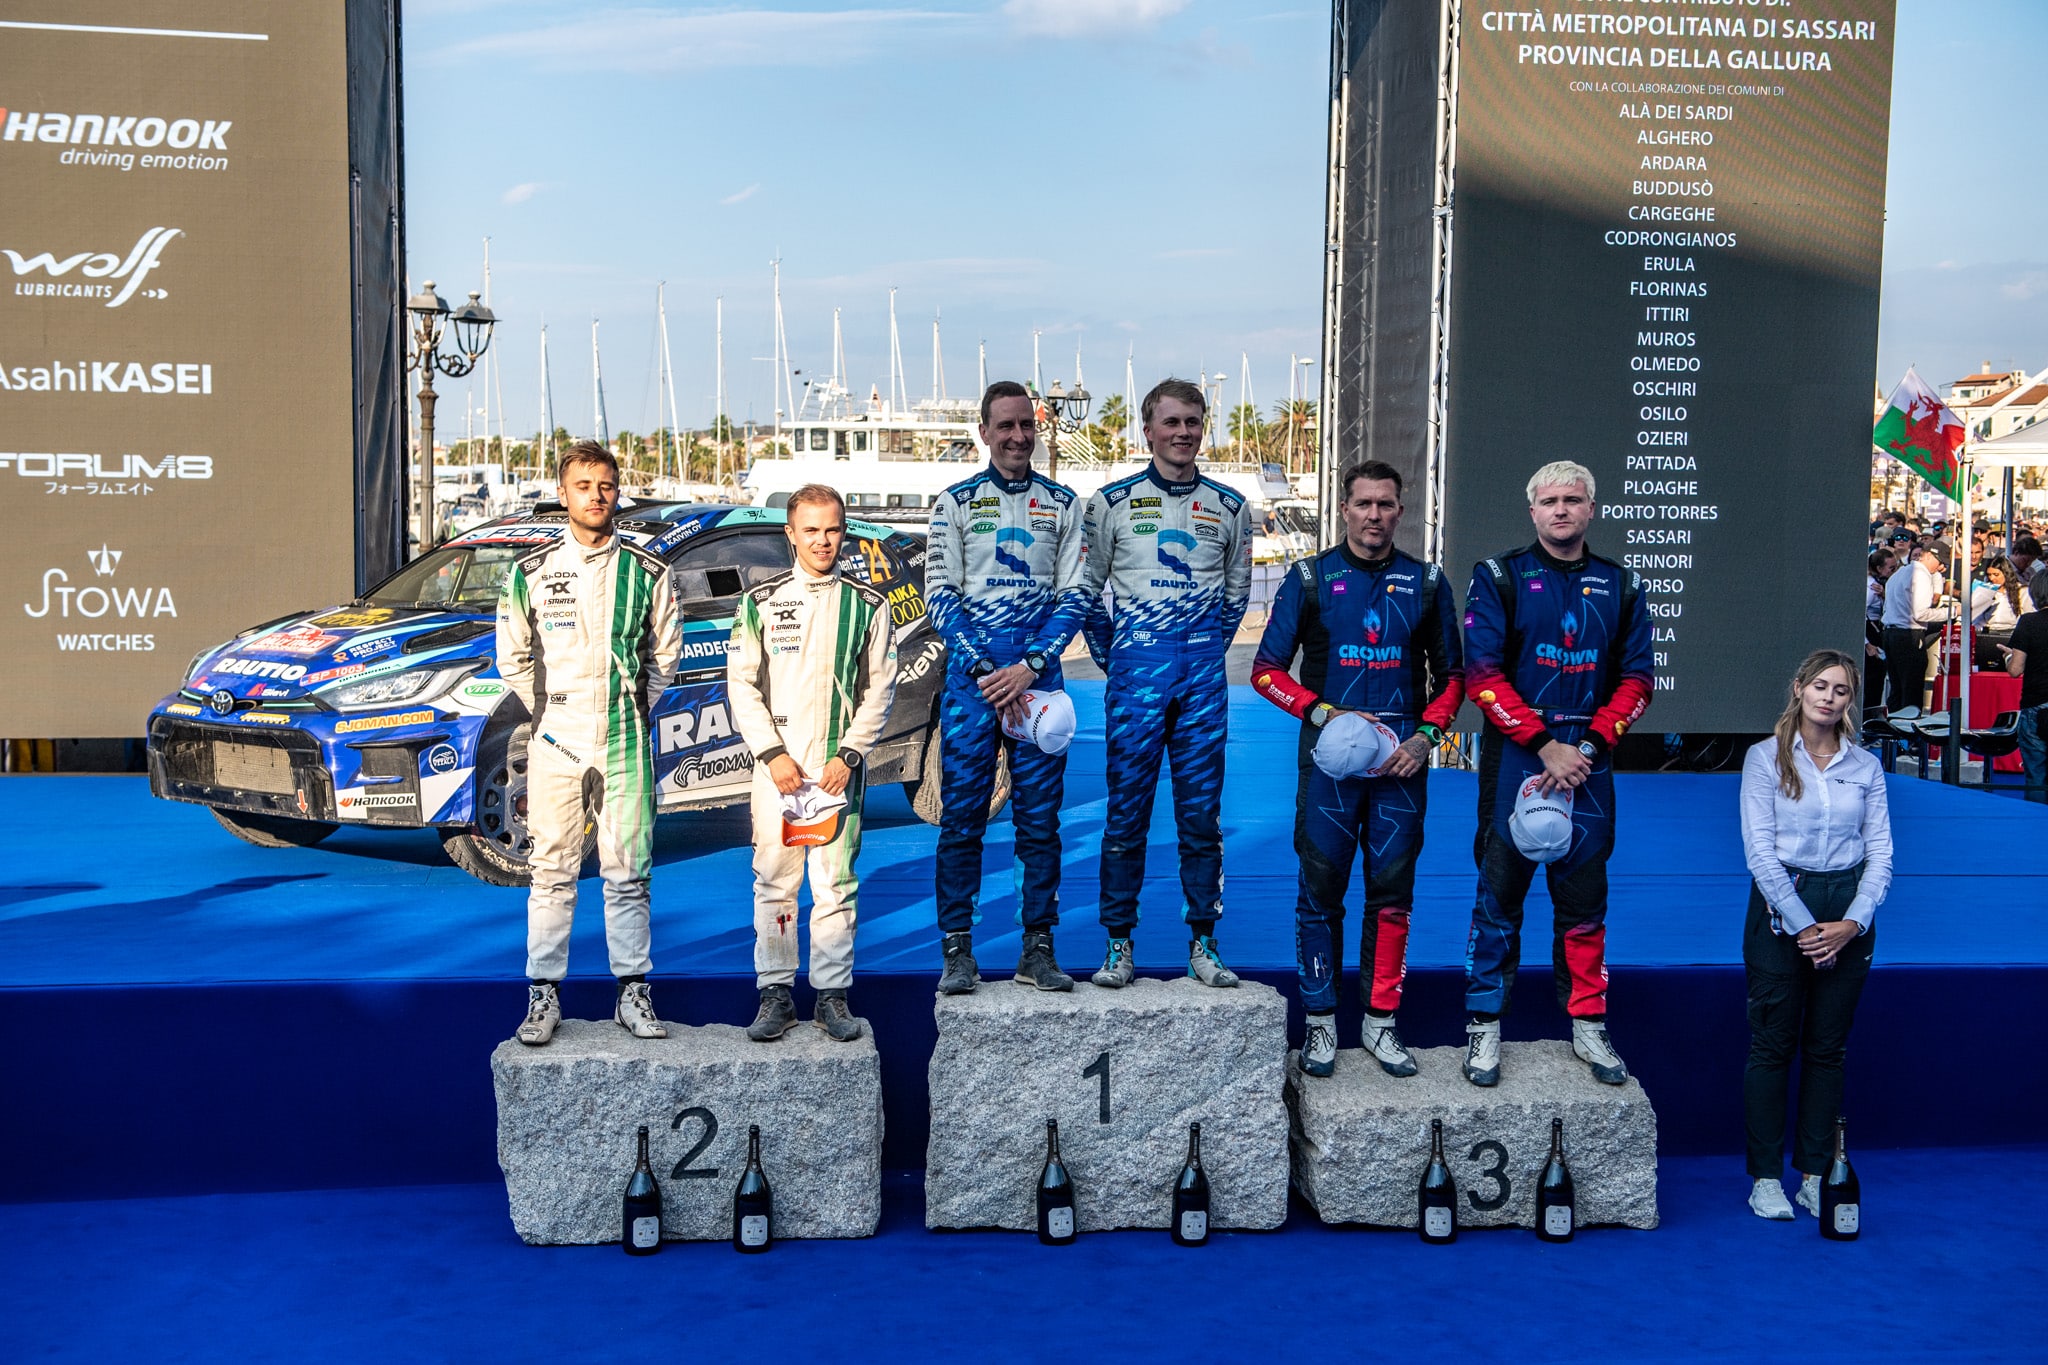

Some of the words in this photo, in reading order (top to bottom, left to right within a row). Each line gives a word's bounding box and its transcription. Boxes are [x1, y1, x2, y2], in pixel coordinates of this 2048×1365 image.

[1482, 9, 1545, 32] CITTÀ
[1553, 14, 1746, 36] METROPOLITANA
[1754, 19, 1776, 37] DI
[1782, 20, 1875, 40] SASSARI
[1519, 45, 1643, 66] PROVINCIA
[1650, 48, 1721, 68] DELLA
[1728, 50, 1831, 70] GALLURA
[1570, 82, 1592, 91] CON
[1596, 83, 1608, 91] LA
[1611, 83, 1705, 94] COLLABORAZIONE
[1709, 85, 1725, 94] DEI
[1728, 85, 1770, 95] COMUNI
[1774, 86, 1784, 95] DI
[1620, 102, 1650, 118] ALÀ
[1656, 105, 1680, 119] DEI
[1686, 106, 1732, 120] SARDI
[1638, 130, 1713, 145] ALGHERO
[60, 148, 134, 171] driving
[141, 154, 227, 170] emotion
[1641, 156, 1706, 170] ARDARA
[1633, 179, 1713, 196] BUDDUSÒ
[1629, 206, 1715, 221] CARGEGHE
[1605, 231, 1736, 247] CODRONGIANOS
[1645, 257, 1694, 271] ERULA
[16, 283, 112, 297] LUBRICANTS
[1631, 282, 1706, 296] FLORINAS
[1647, 307, 1688, 321] ITTIRI
[1638, 332, 1695, 346] MUROS
[1631, 357, 1700, 371] OLMEDO
[1633, 382, 1696, 396] OSCHIRI
[1641, 407, 1687, 420] OSILO
[1637, 431, 1687, 445] OZIERI
[1627, 456, 1696, 470] PATTADA
[44, 482, 154, 496] フォーラムエイト
[1625, 481, 1697, 495] PLOAGHE
[1602, 505, 1655, 519] PORTO
[1659, 506, 1717, 519] TORRES
[1627, 530, 1690, 543] SASSARI
[1624, 555, 1692, 568] SENNORI
[986, 578, 1037, 588] RAUTIO
[1151, 579, 1198, 589] RAUTIO
[1642, 579, 1683, 592] ORSO
[25, 568, 178, 618] STOWA
[888, 583, 919, 606] AIKA
[543, 610, 576, 618] evecon
[892, 597, 925, 625] OOD
[1650, 604, 1682, 618] RGU
[58, 634, 154, 650] WATCHES
[1133, 631, 1151, 641] OMP
[1339, 644, 1402, 661] CROWN
[1536, 643, 1598, 665] CROWN
[1654, 652, 1667, 666] RI
[212, 658, 308, 681] RAUTIO
[1340, 659, 1361, 667] GAS
[1368, 660, 1400, 670] POWER
[1537, 657, 1557, 668] GAS
[1563, 663, 1596, 674] POWER
[1654, 677, 1674, 690] INI
[335, 711, 434, 733] SJOMAN.COM
[1083, 1053, 1110, 1124] 1
[671, 1107, 718, 1180] 2
[1467, 1140, 1511, 1211] 3
